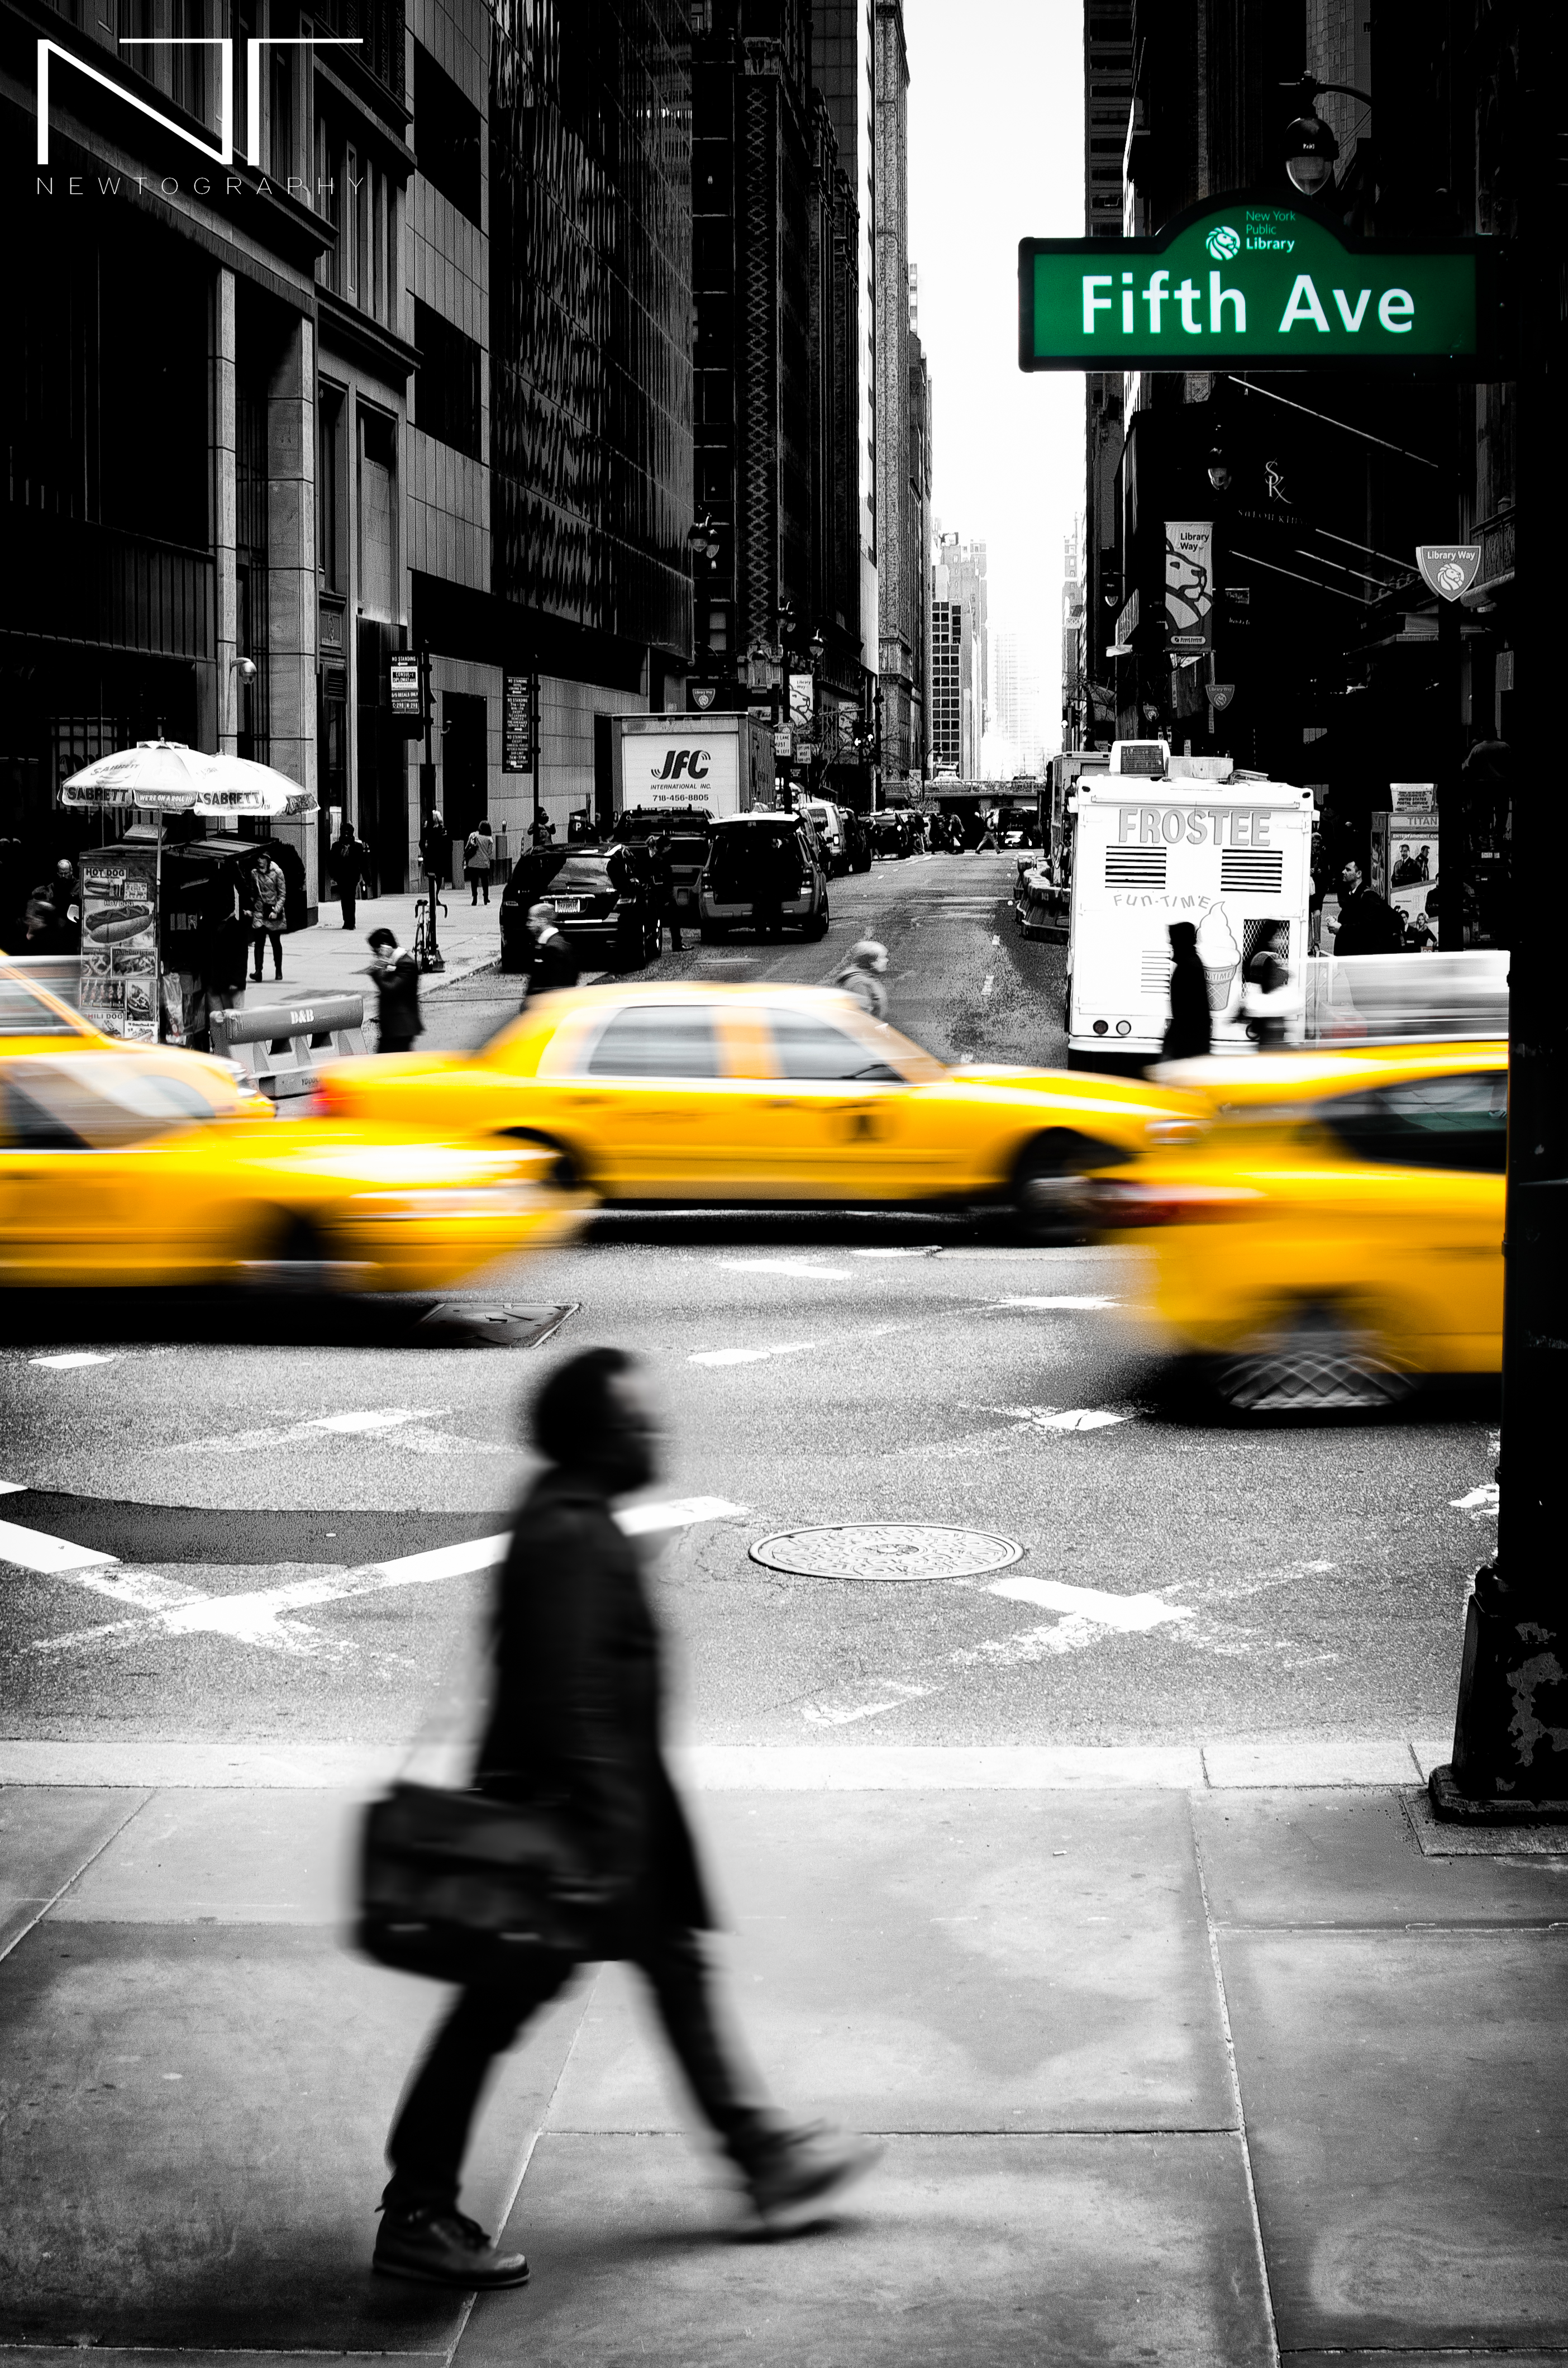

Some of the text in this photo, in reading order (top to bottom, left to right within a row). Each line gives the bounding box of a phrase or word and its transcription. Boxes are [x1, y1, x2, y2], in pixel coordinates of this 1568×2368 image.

[1246, 210, 1295, 221] New York
[1246, 224, 1276, 235] Public
[1246, 236, 1295, 253] Library
[1083, 270, 1414, 334] Fifth Ave
[1180, 532, 1209, 543] Library
[1180, 542, 1198, 552] Way
[1427, 550, 1475, 561] Library Way
[651, 750, 711, 779] JFC
[68, 787, 128, 801] SABRETT
[203, 792, 260, 805] SABRETT
[1118, 808, 1271, 847] FROSTEE
[1407, 817, 1437, 825] TITAN
[290, 1009, 314, 1025] D&B
